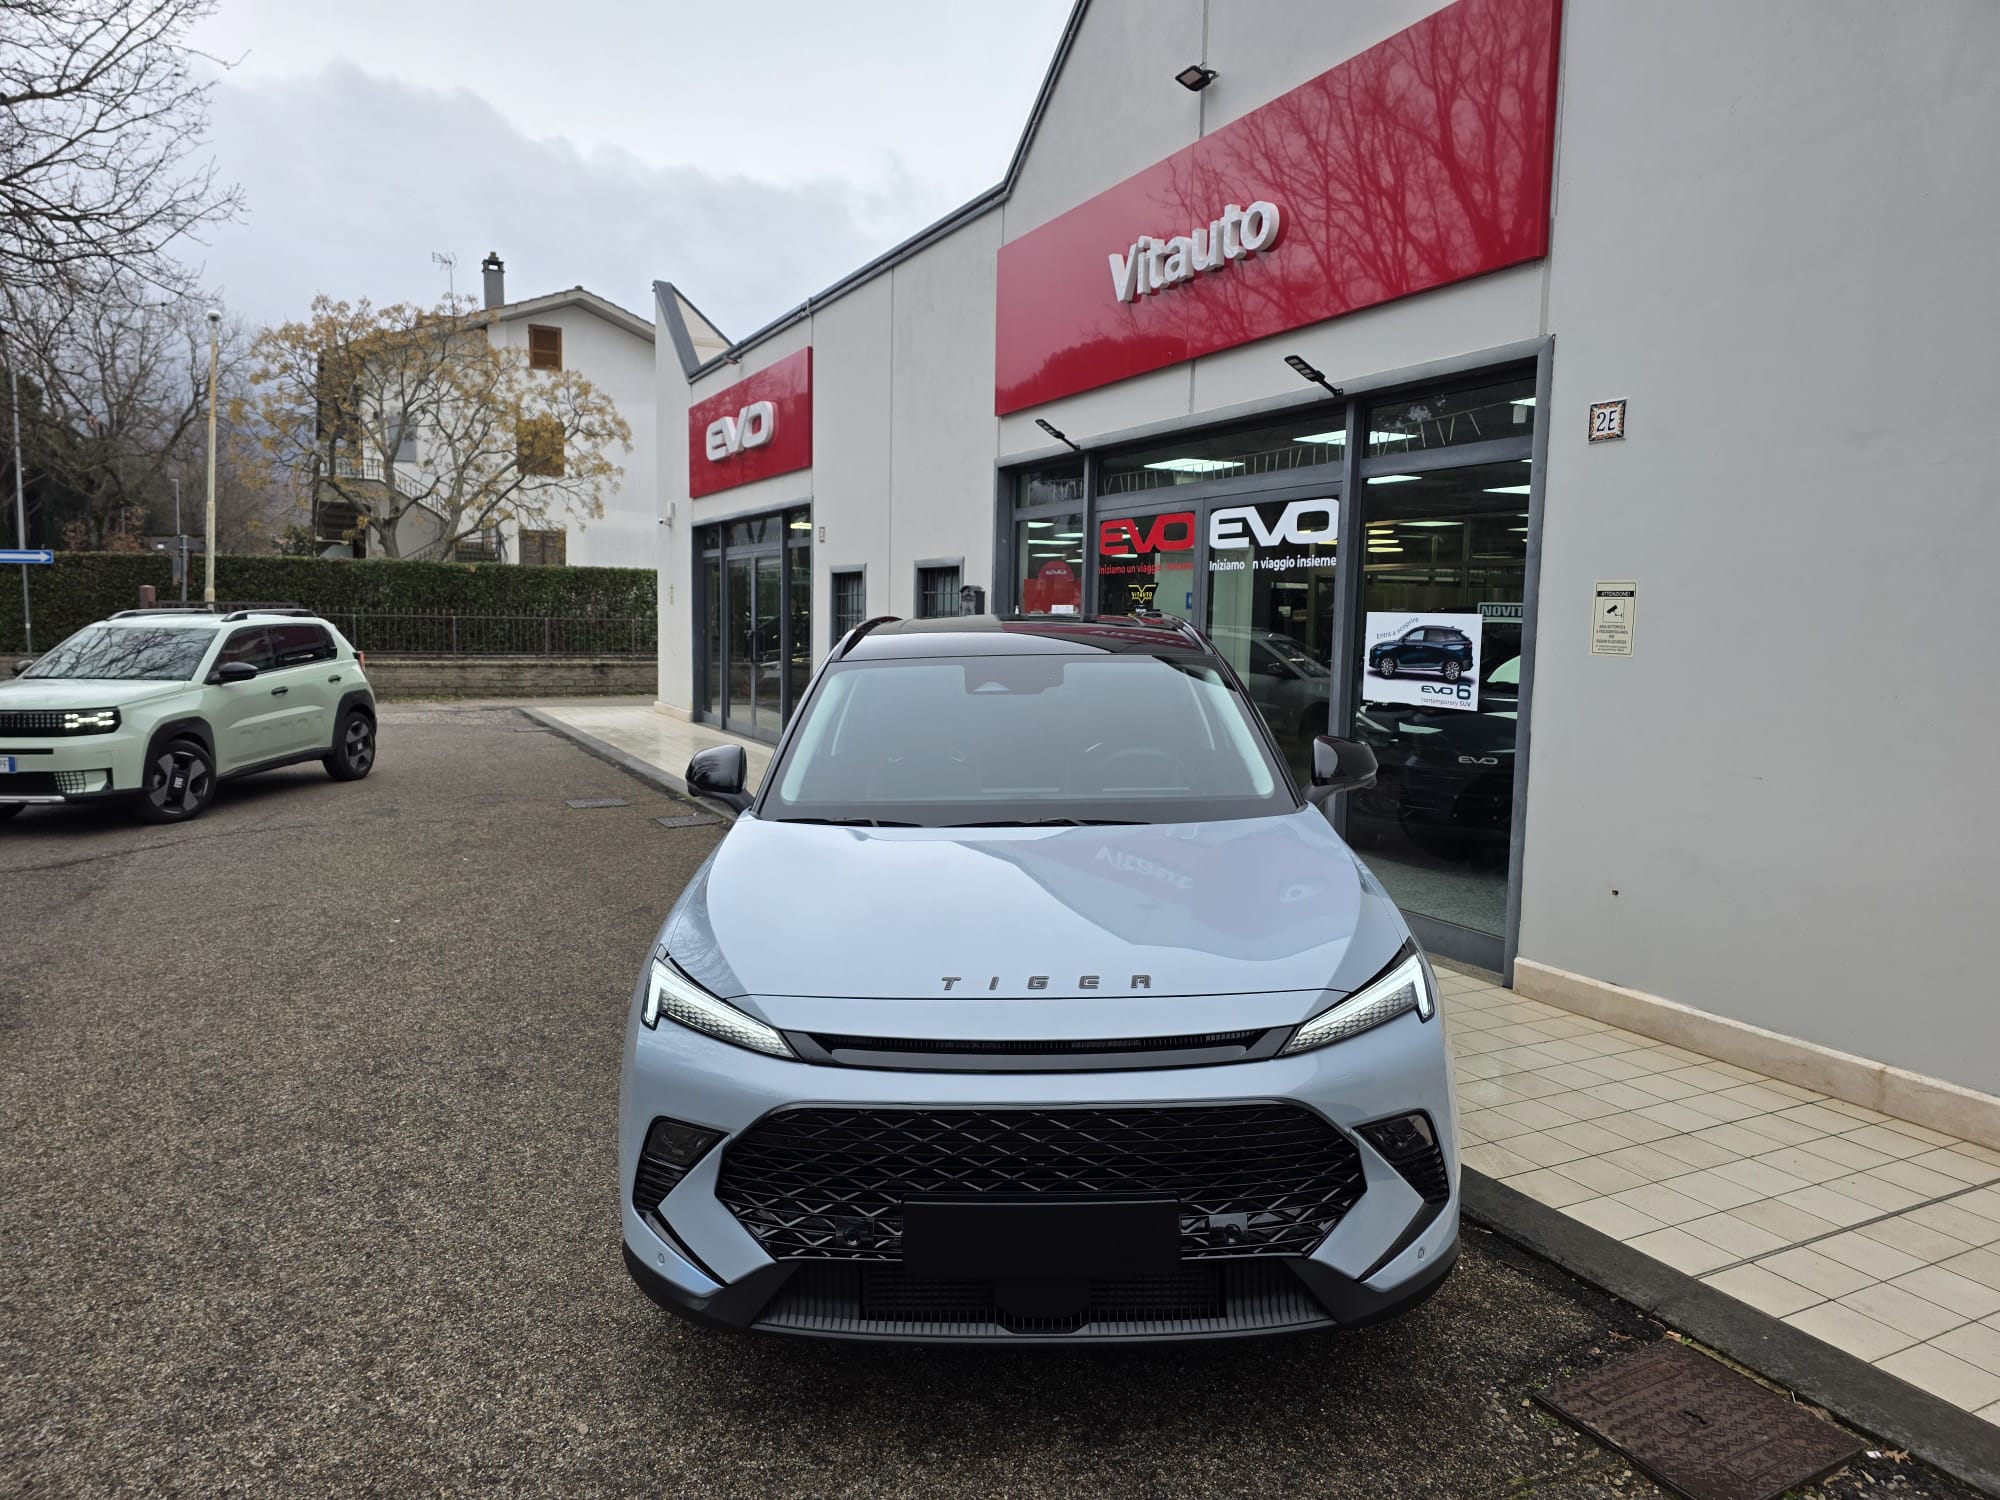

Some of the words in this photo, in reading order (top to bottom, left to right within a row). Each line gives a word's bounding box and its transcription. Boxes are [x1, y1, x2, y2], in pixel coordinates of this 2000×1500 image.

[1108, 201, 1279, 302] Vitauto
[1596, 410, 1617, 432] 2E
[706, 401, 774, 461] EVO
[1209, 499, 1339, 549] EVO
[1100, 513, 1195, 555] EVO
[1127, 565, 1136, 573] un
[1209, 558, 1245, 571] Iniziamo
[1261, 556, 1295, 571] viaggio
[1297, 555, 1337, 567] insieme
[1376, 632, 1391, 640] Entra
[1421, 685, 1453, 695] EVO
[1456, 682, 1471, 700] 6
[1458, 756, 1498, 765] EVO
[941, 974, 1152, 991] TIGER
